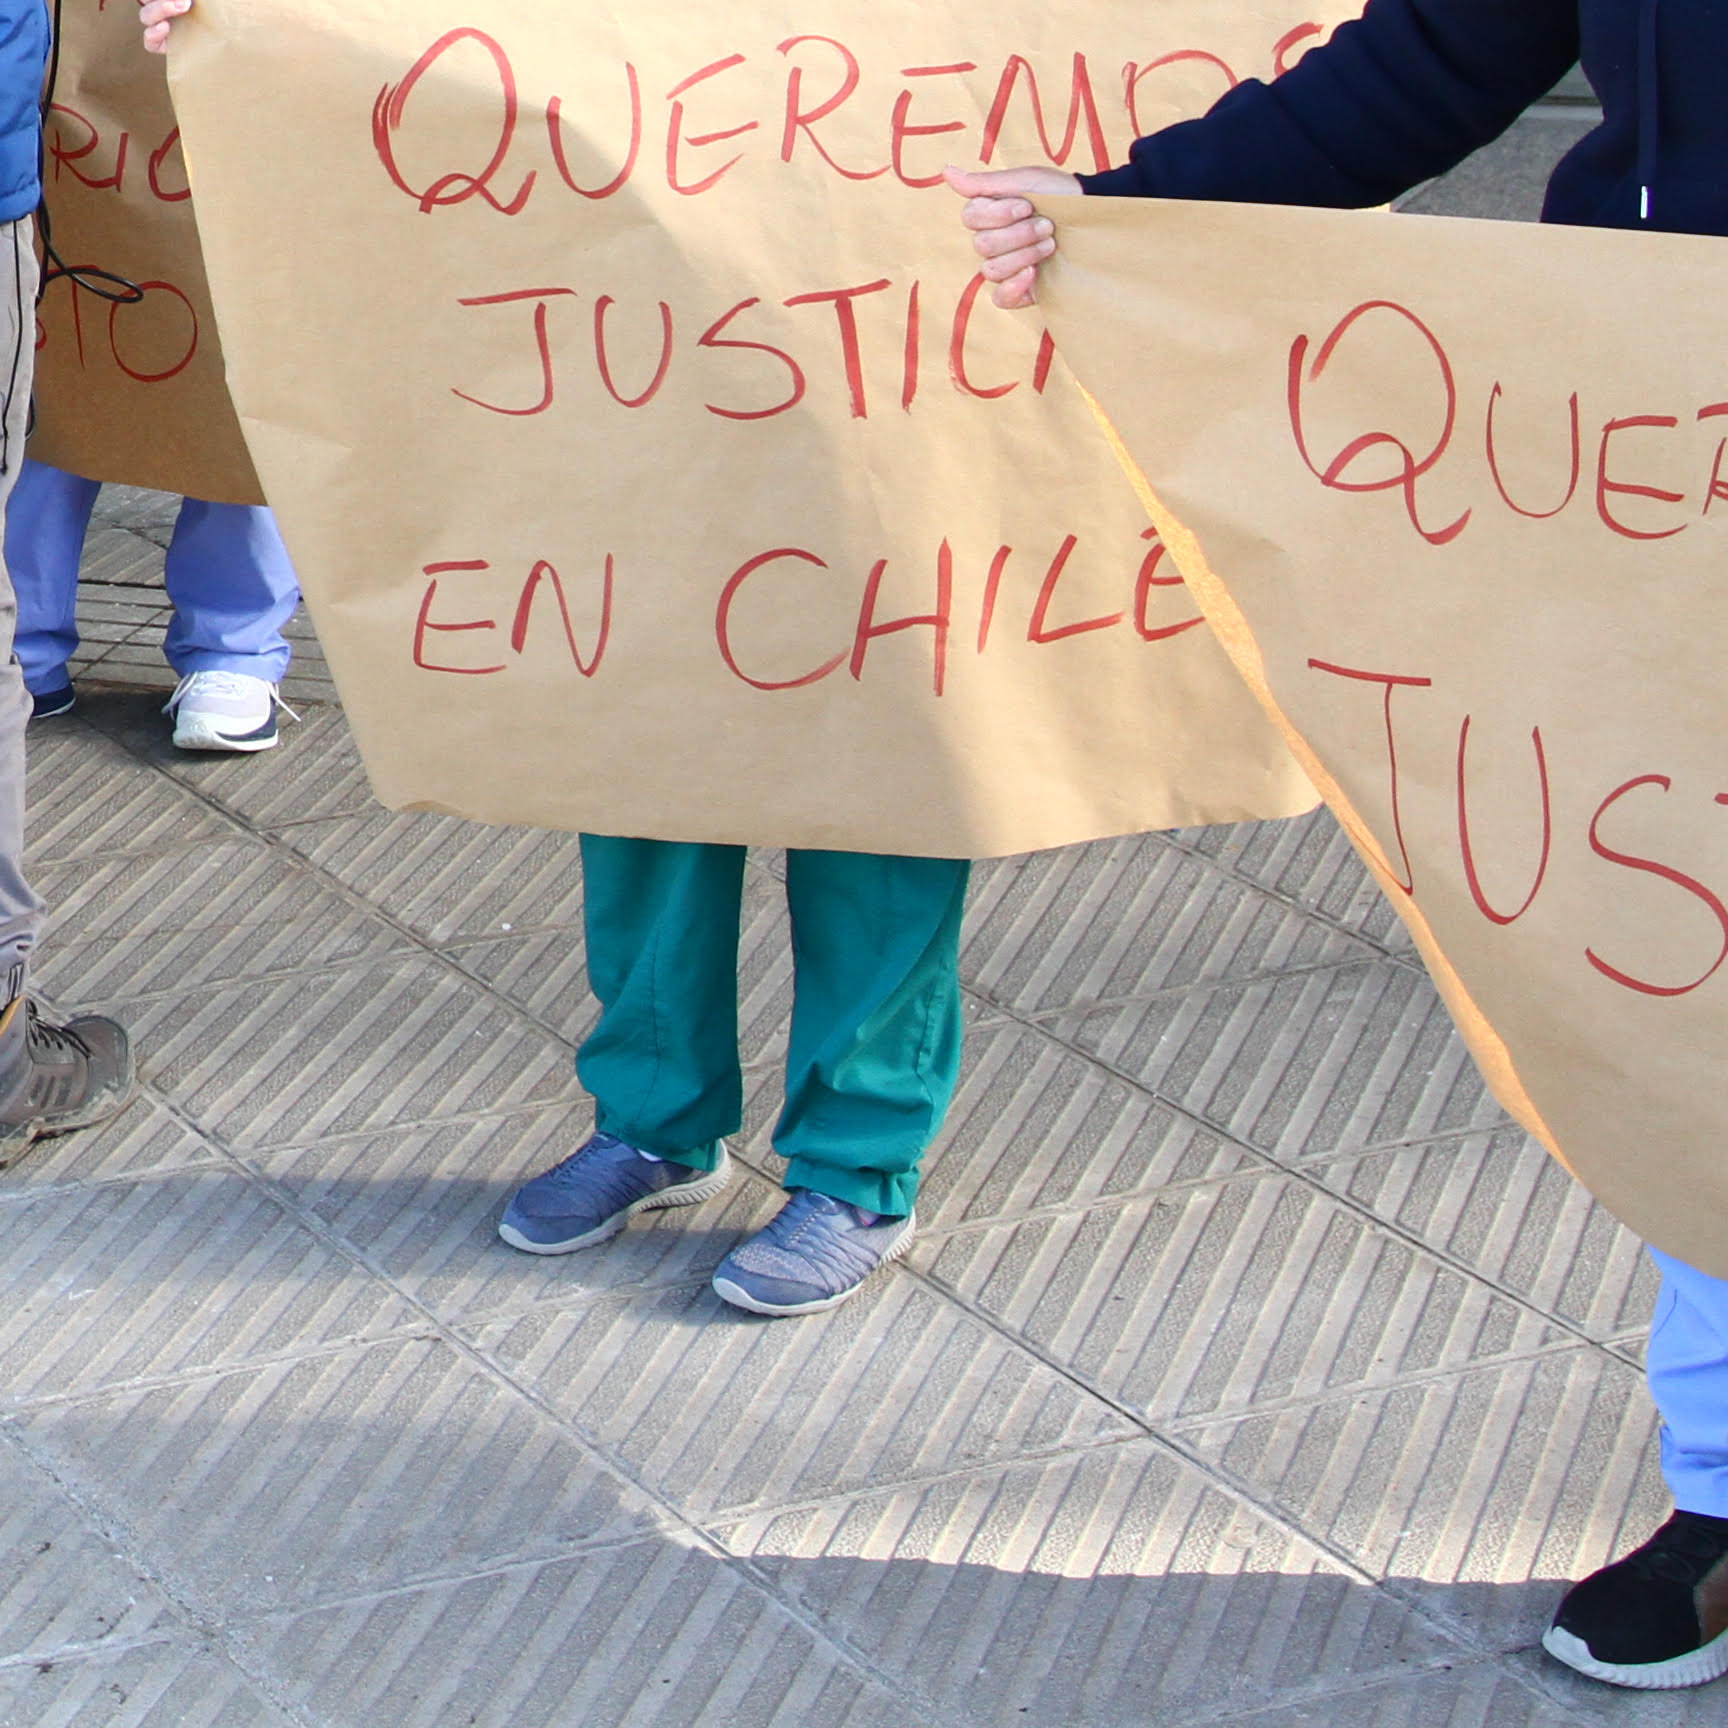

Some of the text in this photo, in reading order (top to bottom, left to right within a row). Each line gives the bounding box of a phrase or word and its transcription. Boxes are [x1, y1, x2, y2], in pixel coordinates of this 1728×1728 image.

[371, 23, 1325, 217] QUEREMO
[412, 524, 1208, 698] EN CHILE
